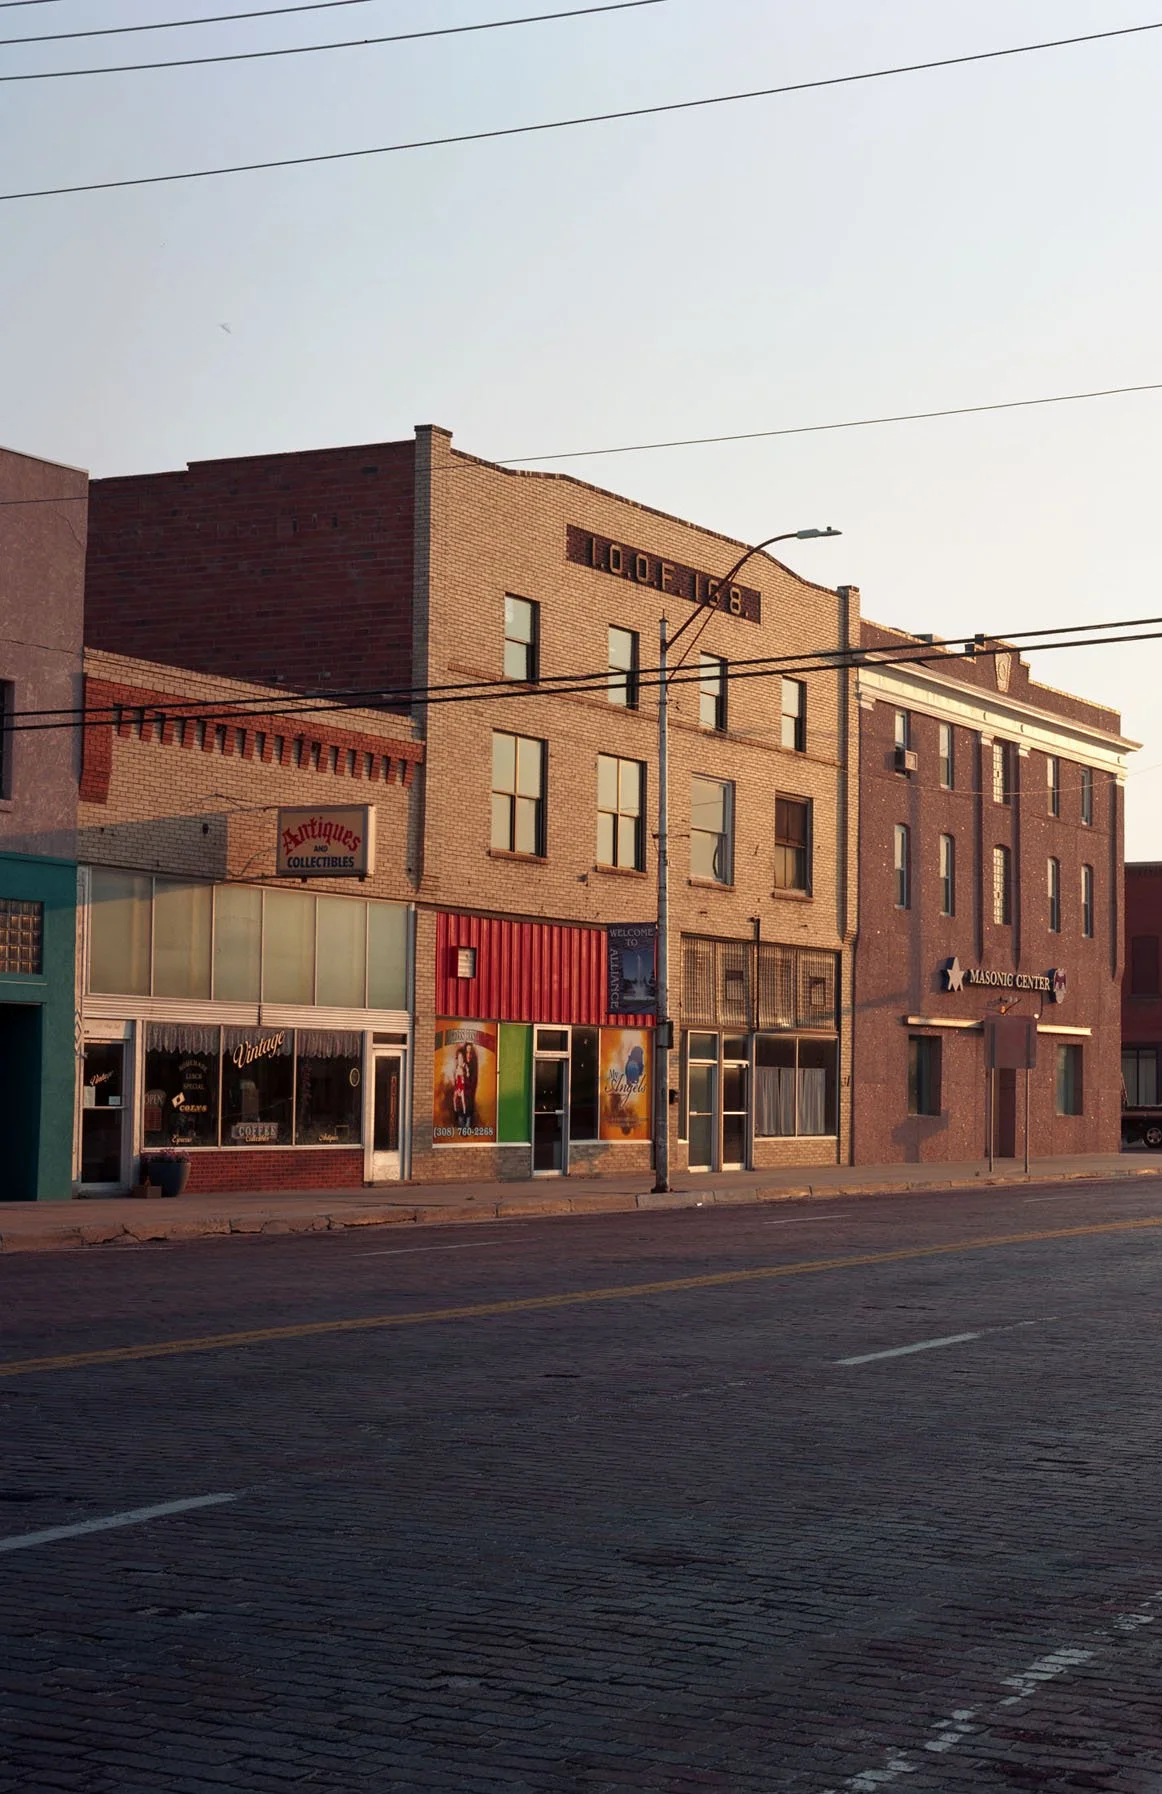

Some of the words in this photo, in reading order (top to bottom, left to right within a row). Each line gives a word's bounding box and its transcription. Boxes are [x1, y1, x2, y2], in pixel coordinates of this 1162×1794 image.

[282, 816, 361, 856] Antiques
[287, 856, 354, 868] COLLECTIBLES
[609, 928, 654, 937] WELCOME
[625, 939, 638, 947] TO
[610, 948, 620, 1009] ALLIANCE
[970, 968, 1014, 987] MASONIC
[1015, 973, 1051, 991] CENTER
[233, 1030, 285, 1069] Vintage
[609, 1068, 619, 1080] My
[604, 1074, 647, 1107] Angels
[238, 1125, 277, 1137] COFFEE
[433, 1127, 455, 1138] (308)
